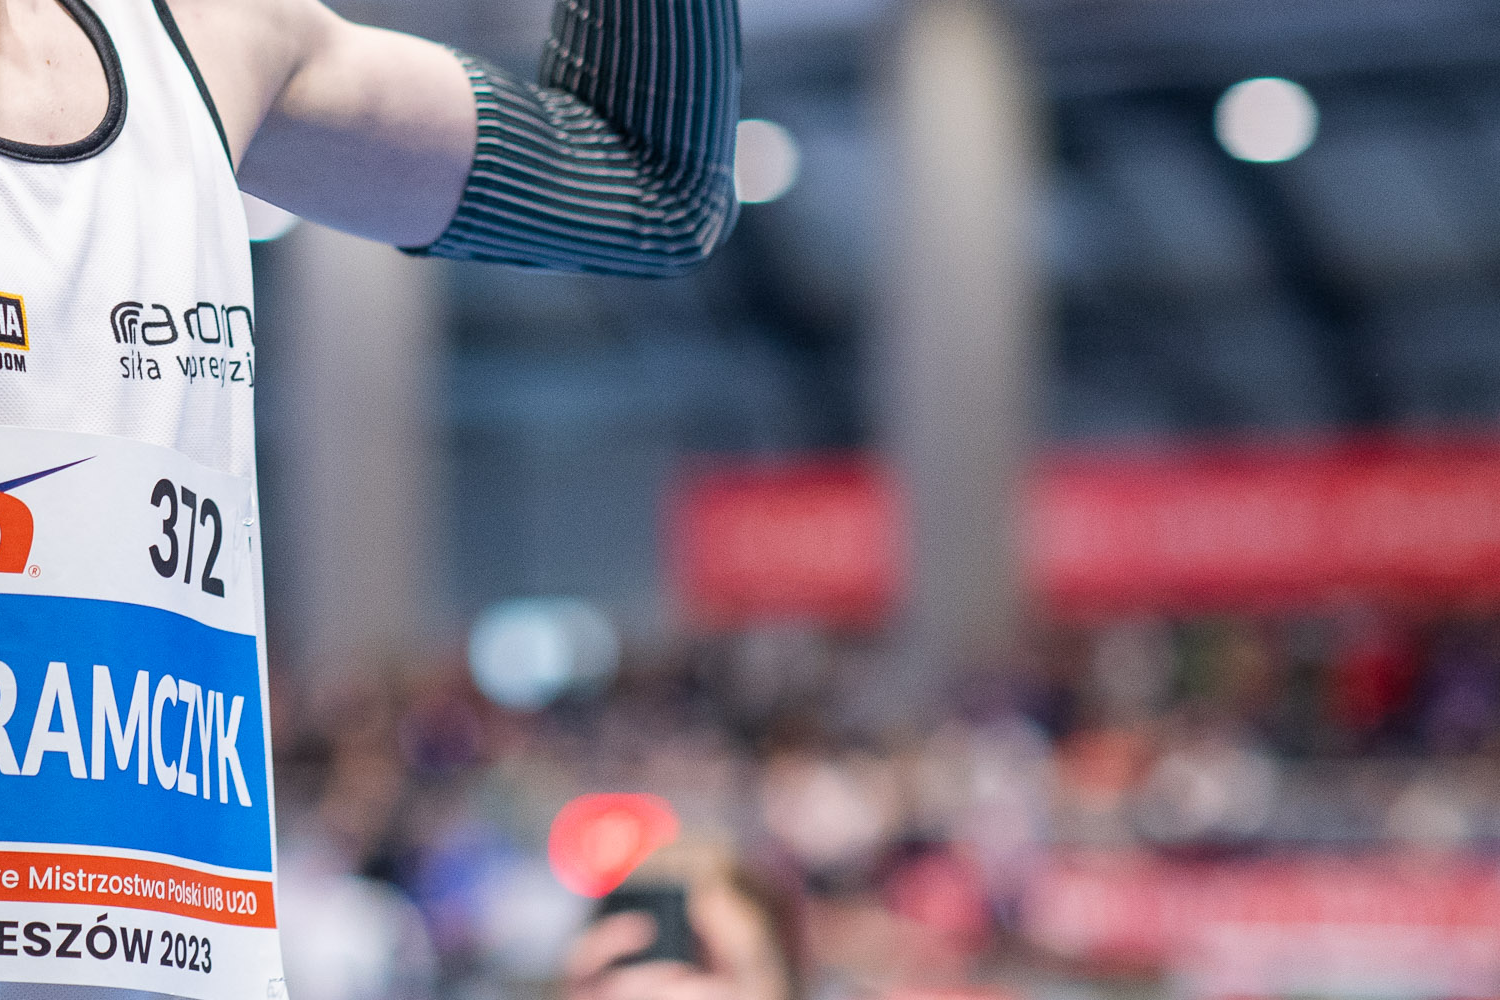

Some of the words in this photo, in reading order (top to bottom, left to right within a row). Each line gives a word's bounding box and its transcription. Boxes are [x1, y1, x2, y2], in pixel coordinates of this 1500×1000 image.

[120, 349, 161, 380] siła
[149, 479, 225, 598] 372
[28, 865, 165, 899] Mistrzostwa
[168, 878, 201, 907] Polski
[203, 886, 223, 912] U18
[226, 890, 257, 915] U20
[160, 930, 212, 974] 2023
